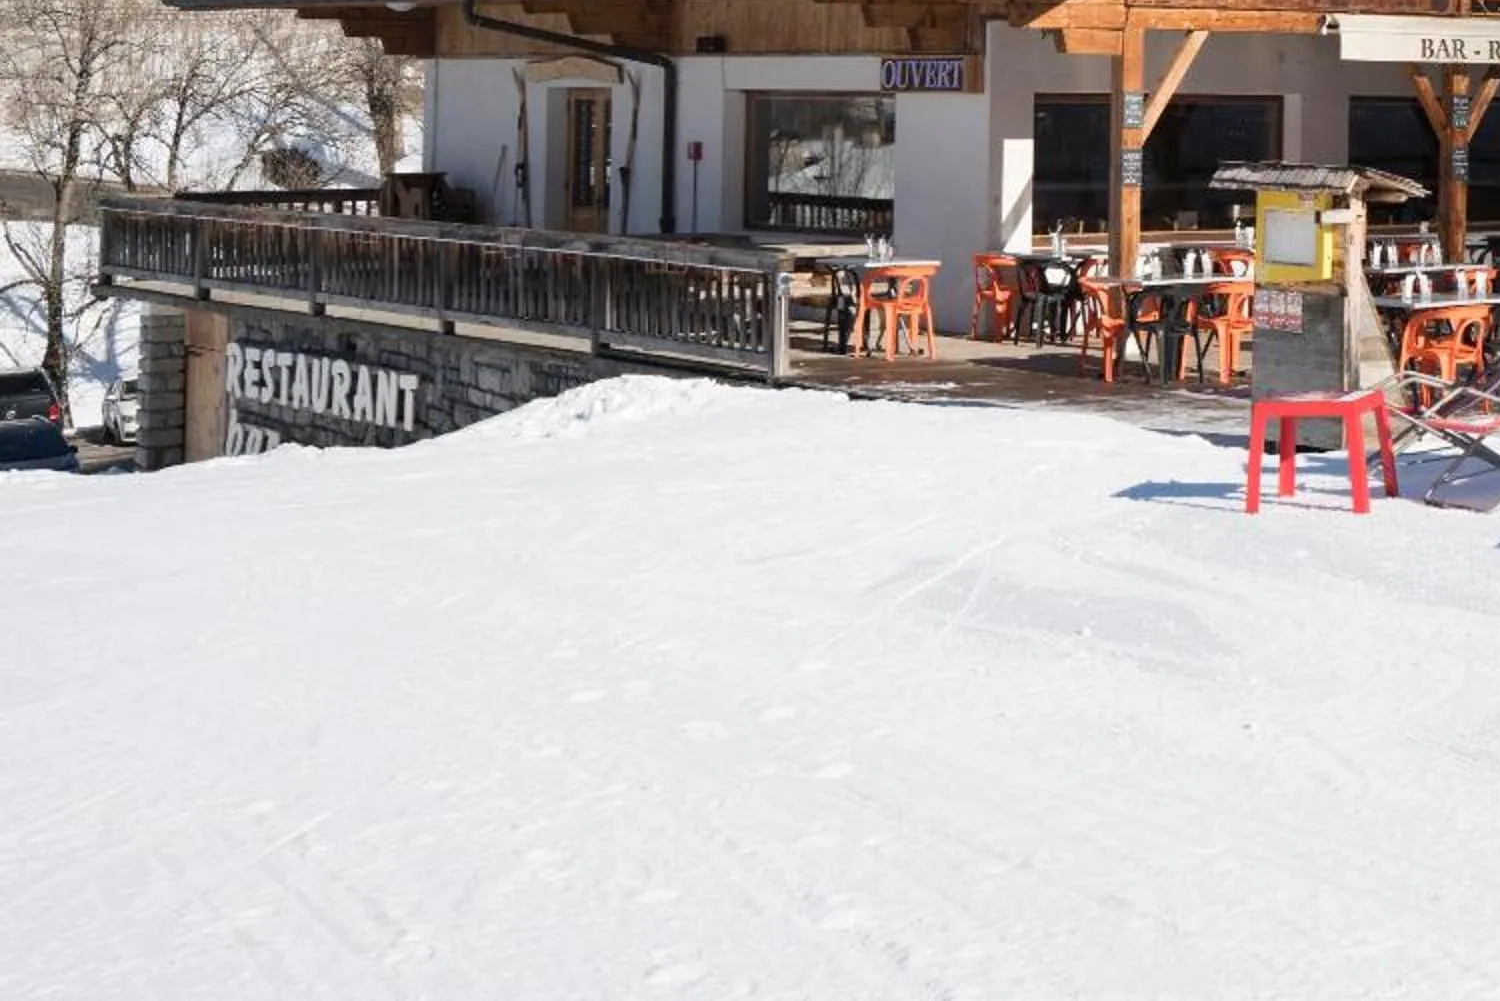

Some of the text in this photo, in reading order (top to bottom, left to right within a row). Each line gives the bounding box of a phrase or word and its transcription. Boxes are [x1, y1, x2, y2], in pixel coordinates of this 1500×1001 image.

[1421, 38, 1467, 60] BAR
[881, 59, 962, 89] OUVERT
[226, 342, 420, 432] RESTAURANT
